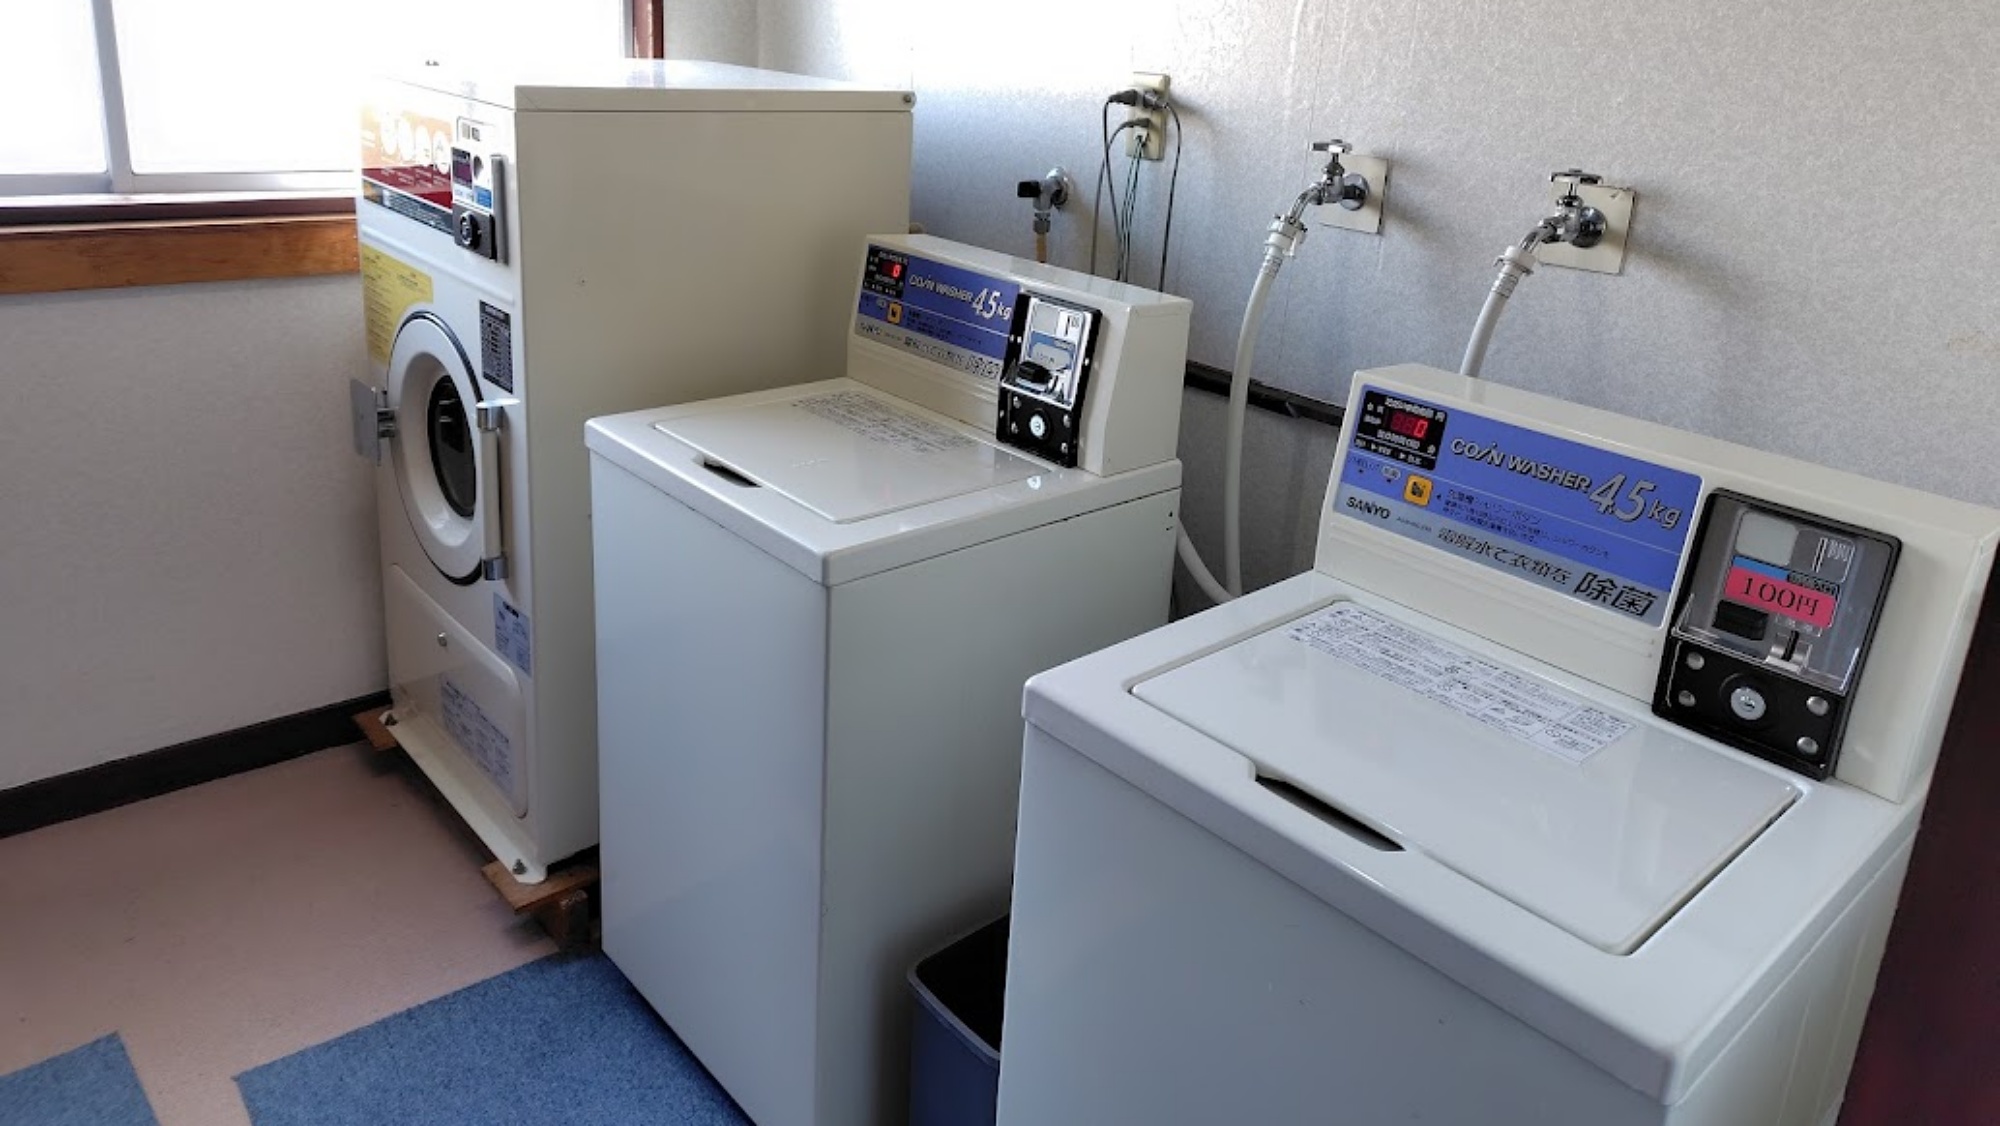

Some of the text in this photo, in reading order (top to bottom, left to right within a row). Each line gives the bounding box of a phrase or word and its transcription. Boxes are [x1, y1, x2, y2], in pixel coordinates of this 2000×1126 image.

[1508, 454, 1593, 493] WASHER
[1346, 496, 1391, 519] SANYO
[1574, 571, 1659, 617] 除菌
[1743, 577, 1819, 617] 100円
